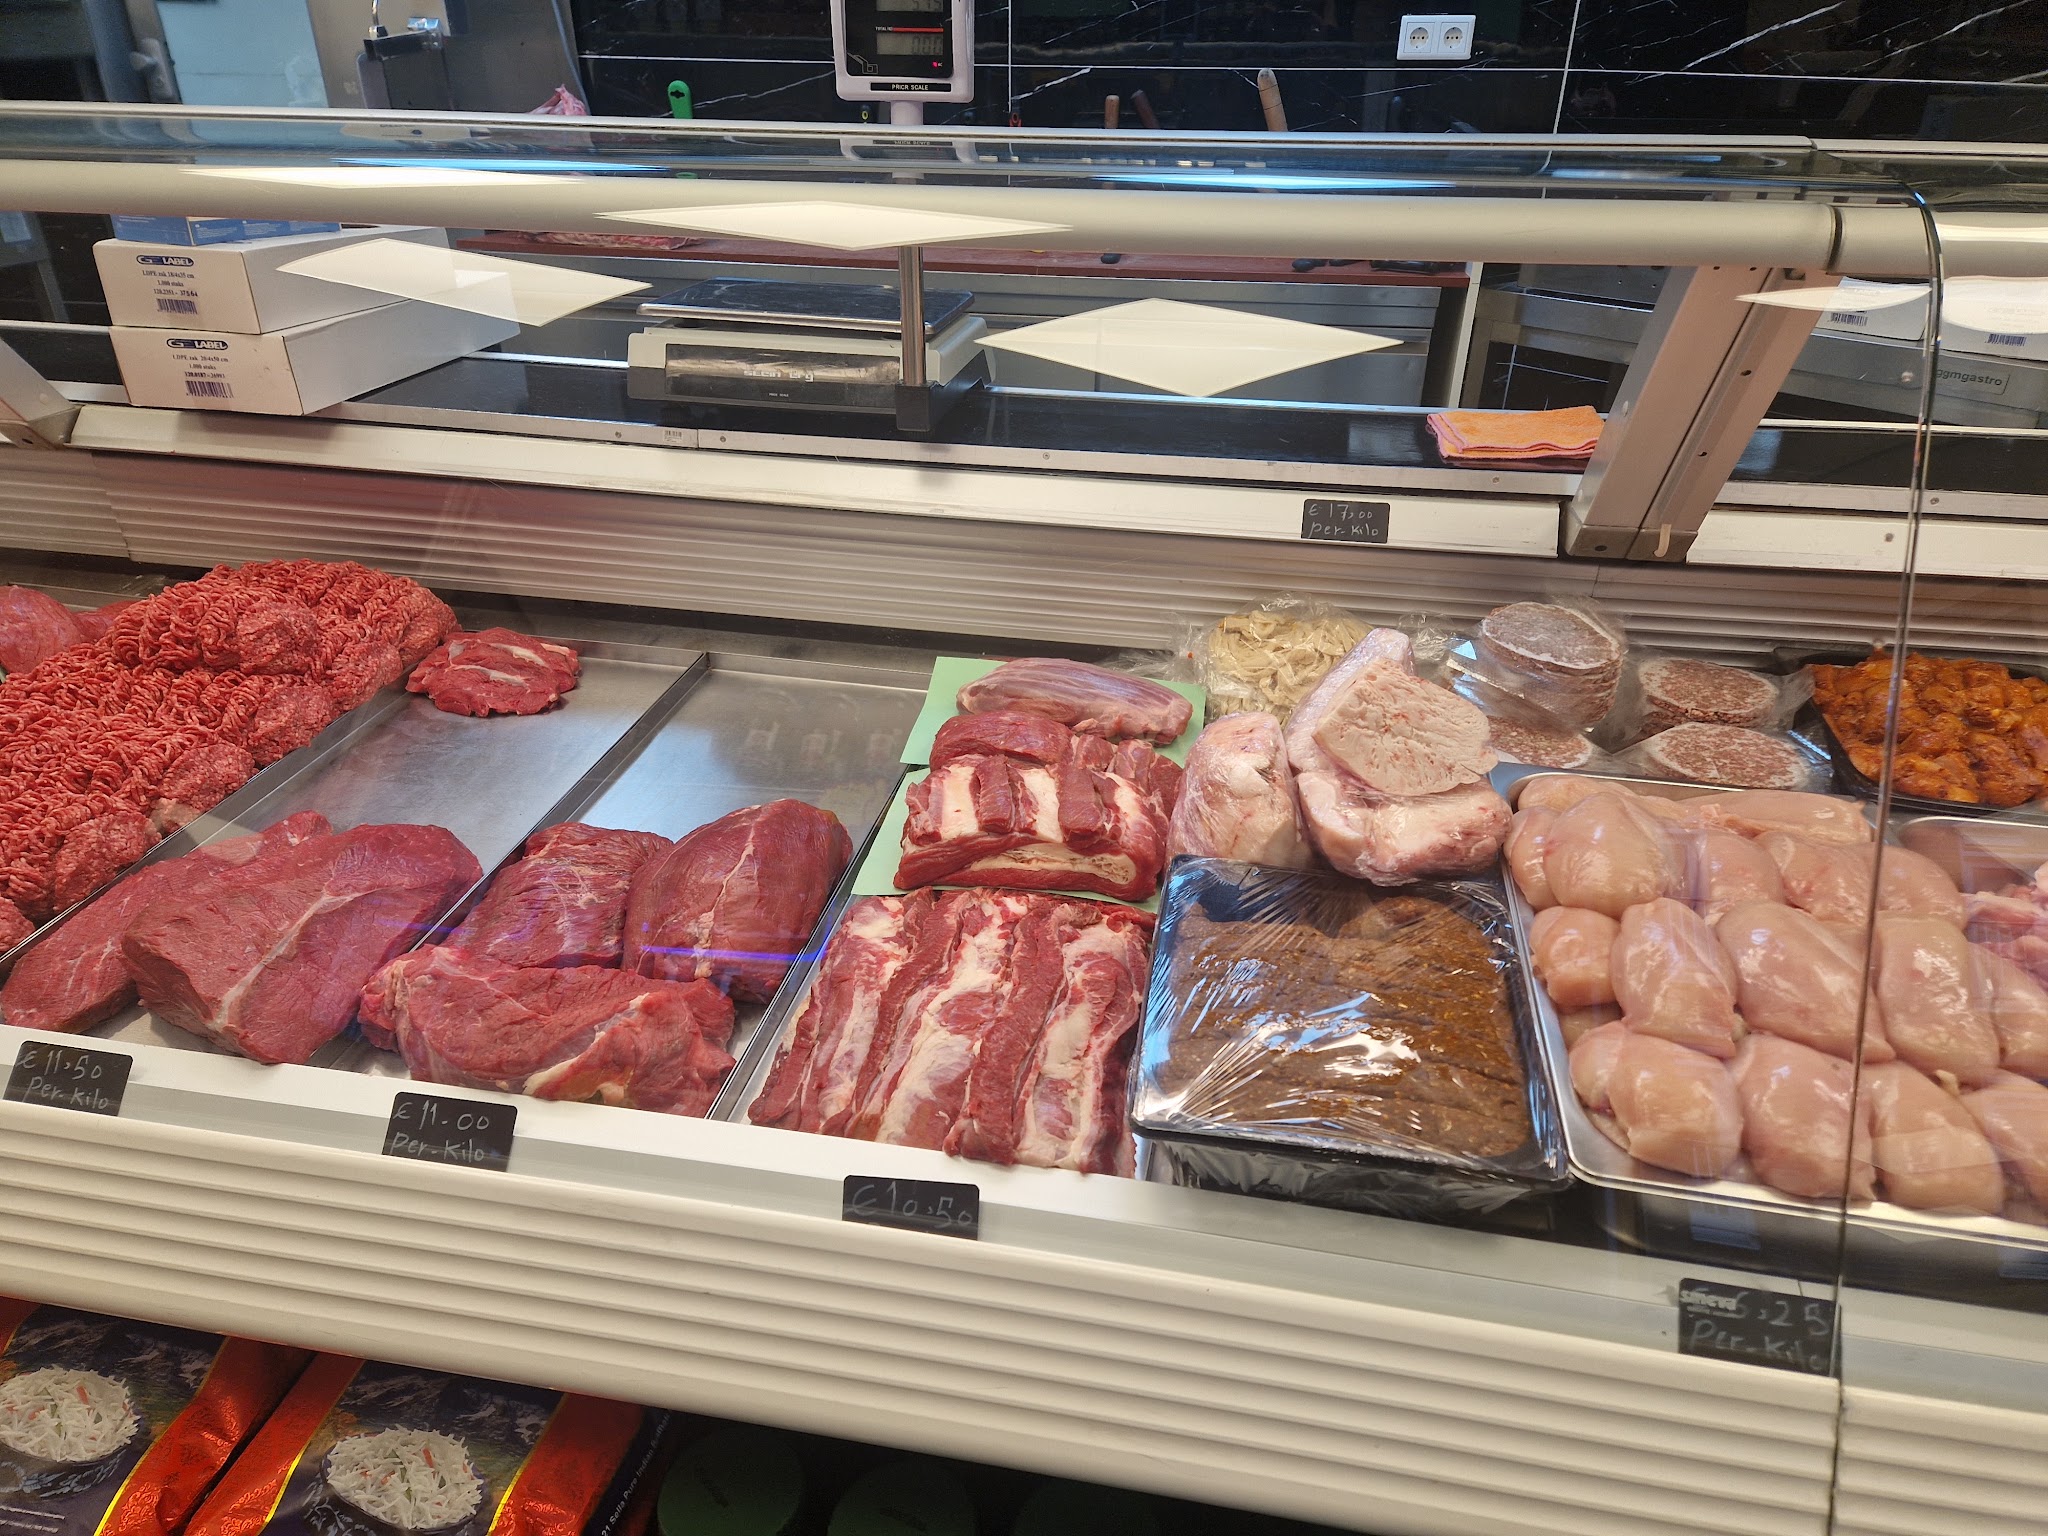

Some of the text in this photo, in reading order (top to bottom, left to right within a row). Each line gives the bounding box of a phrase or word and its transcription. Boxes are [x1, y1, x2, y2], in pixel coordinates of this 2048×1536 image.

[161, 256, 193, 266] LABEL
[194, 340, 228, 350] LABEL
[1937, 369, 2003, 386] ggmgastro
[609, 1500, 625, 1525] Sella
[623, 1477, 638, 1500] Pure
[636, 1448, 654, 1477] Indian
